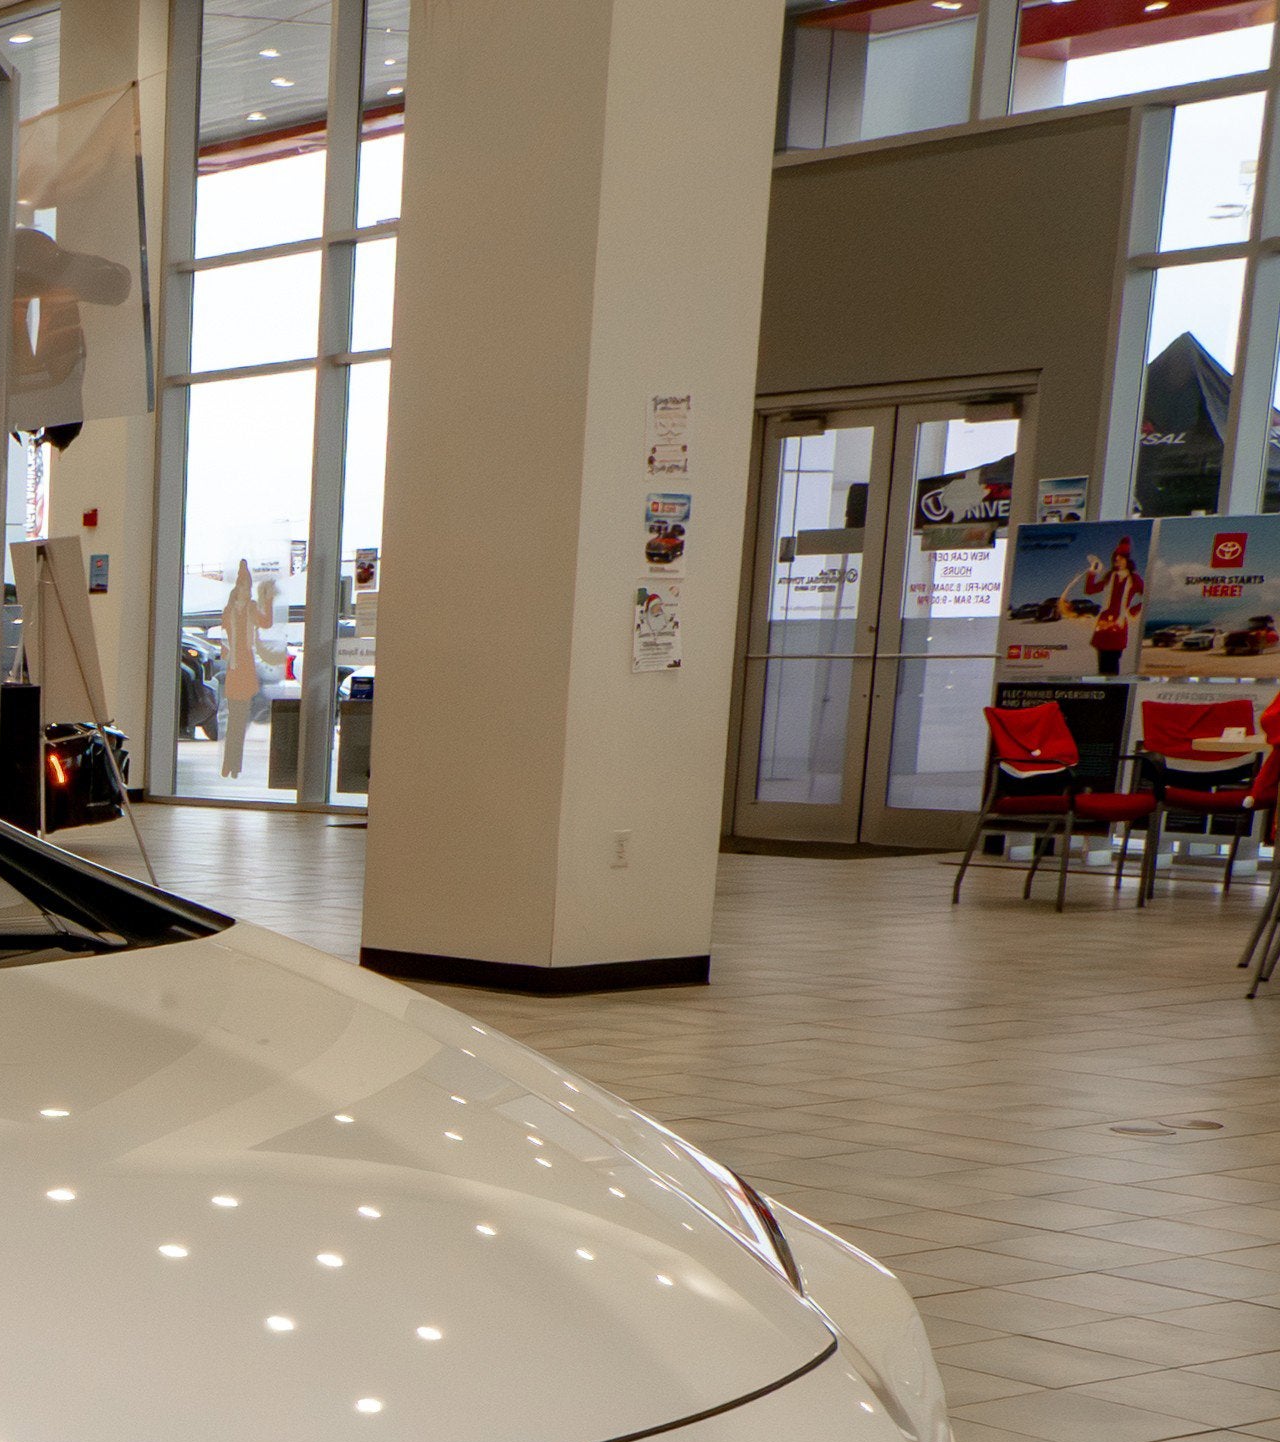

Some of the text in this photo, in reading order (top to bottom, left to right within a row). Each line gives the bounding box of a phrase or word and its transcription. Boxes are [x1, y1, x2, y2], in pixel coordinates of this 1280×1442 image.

[966, 499, 1011, 519] NIVE
[1184, 575, 1265, 586] SUMMER STARTS
[1202, 584, 1244, 598] HERE!
